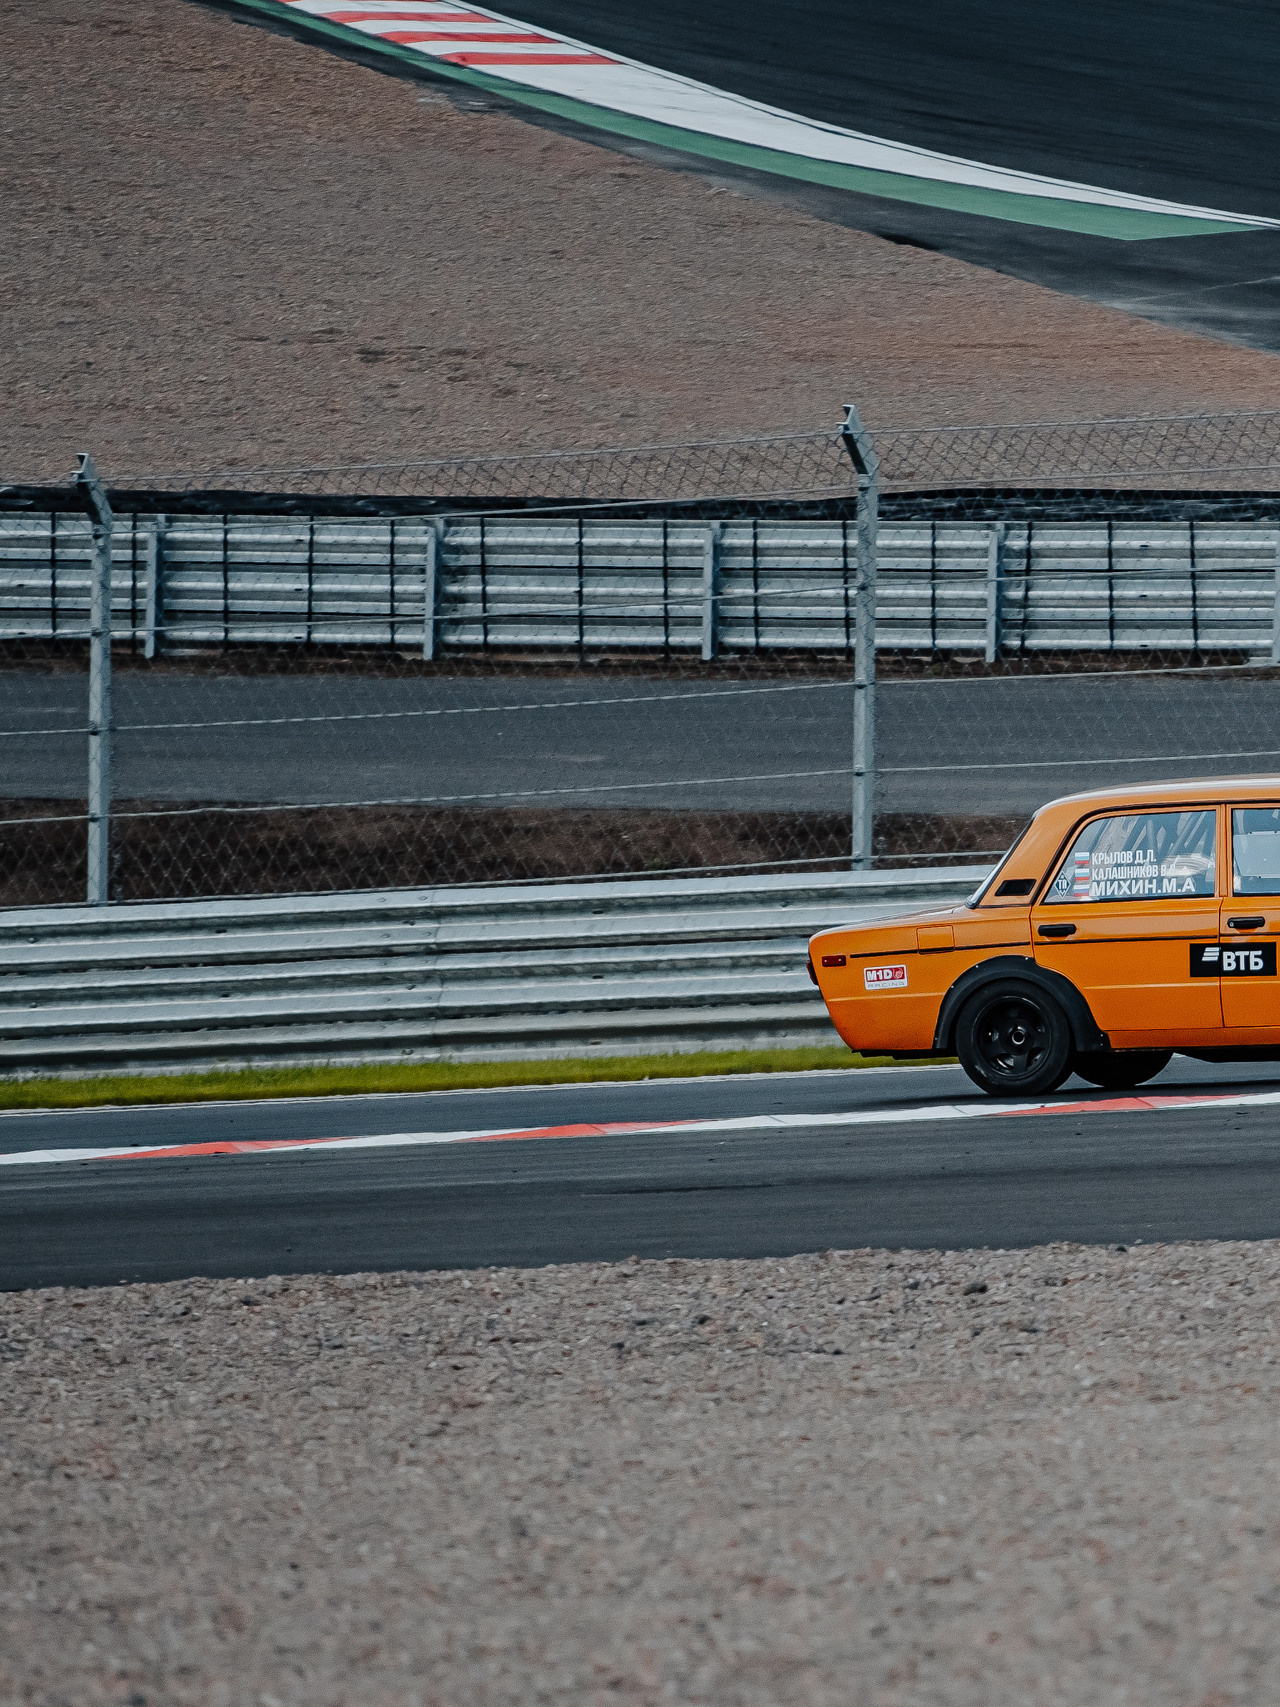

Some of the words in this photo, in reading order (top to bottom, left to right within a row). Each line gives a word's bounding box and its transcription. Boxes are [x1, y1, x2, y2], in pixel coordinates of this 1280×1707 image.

[1092, 852, 1133, 866] КРЫЛОВ
[1134, 850, 1157, 865] Д.Л.
[1092, 865, 1159, 880] КАЛАШНИКОВ
[1091, 877, 1196, 896] МИХИН.М.А
[1223, 950, 1264, 971] ВТБ
[866, 969, 892, 981] M1D
